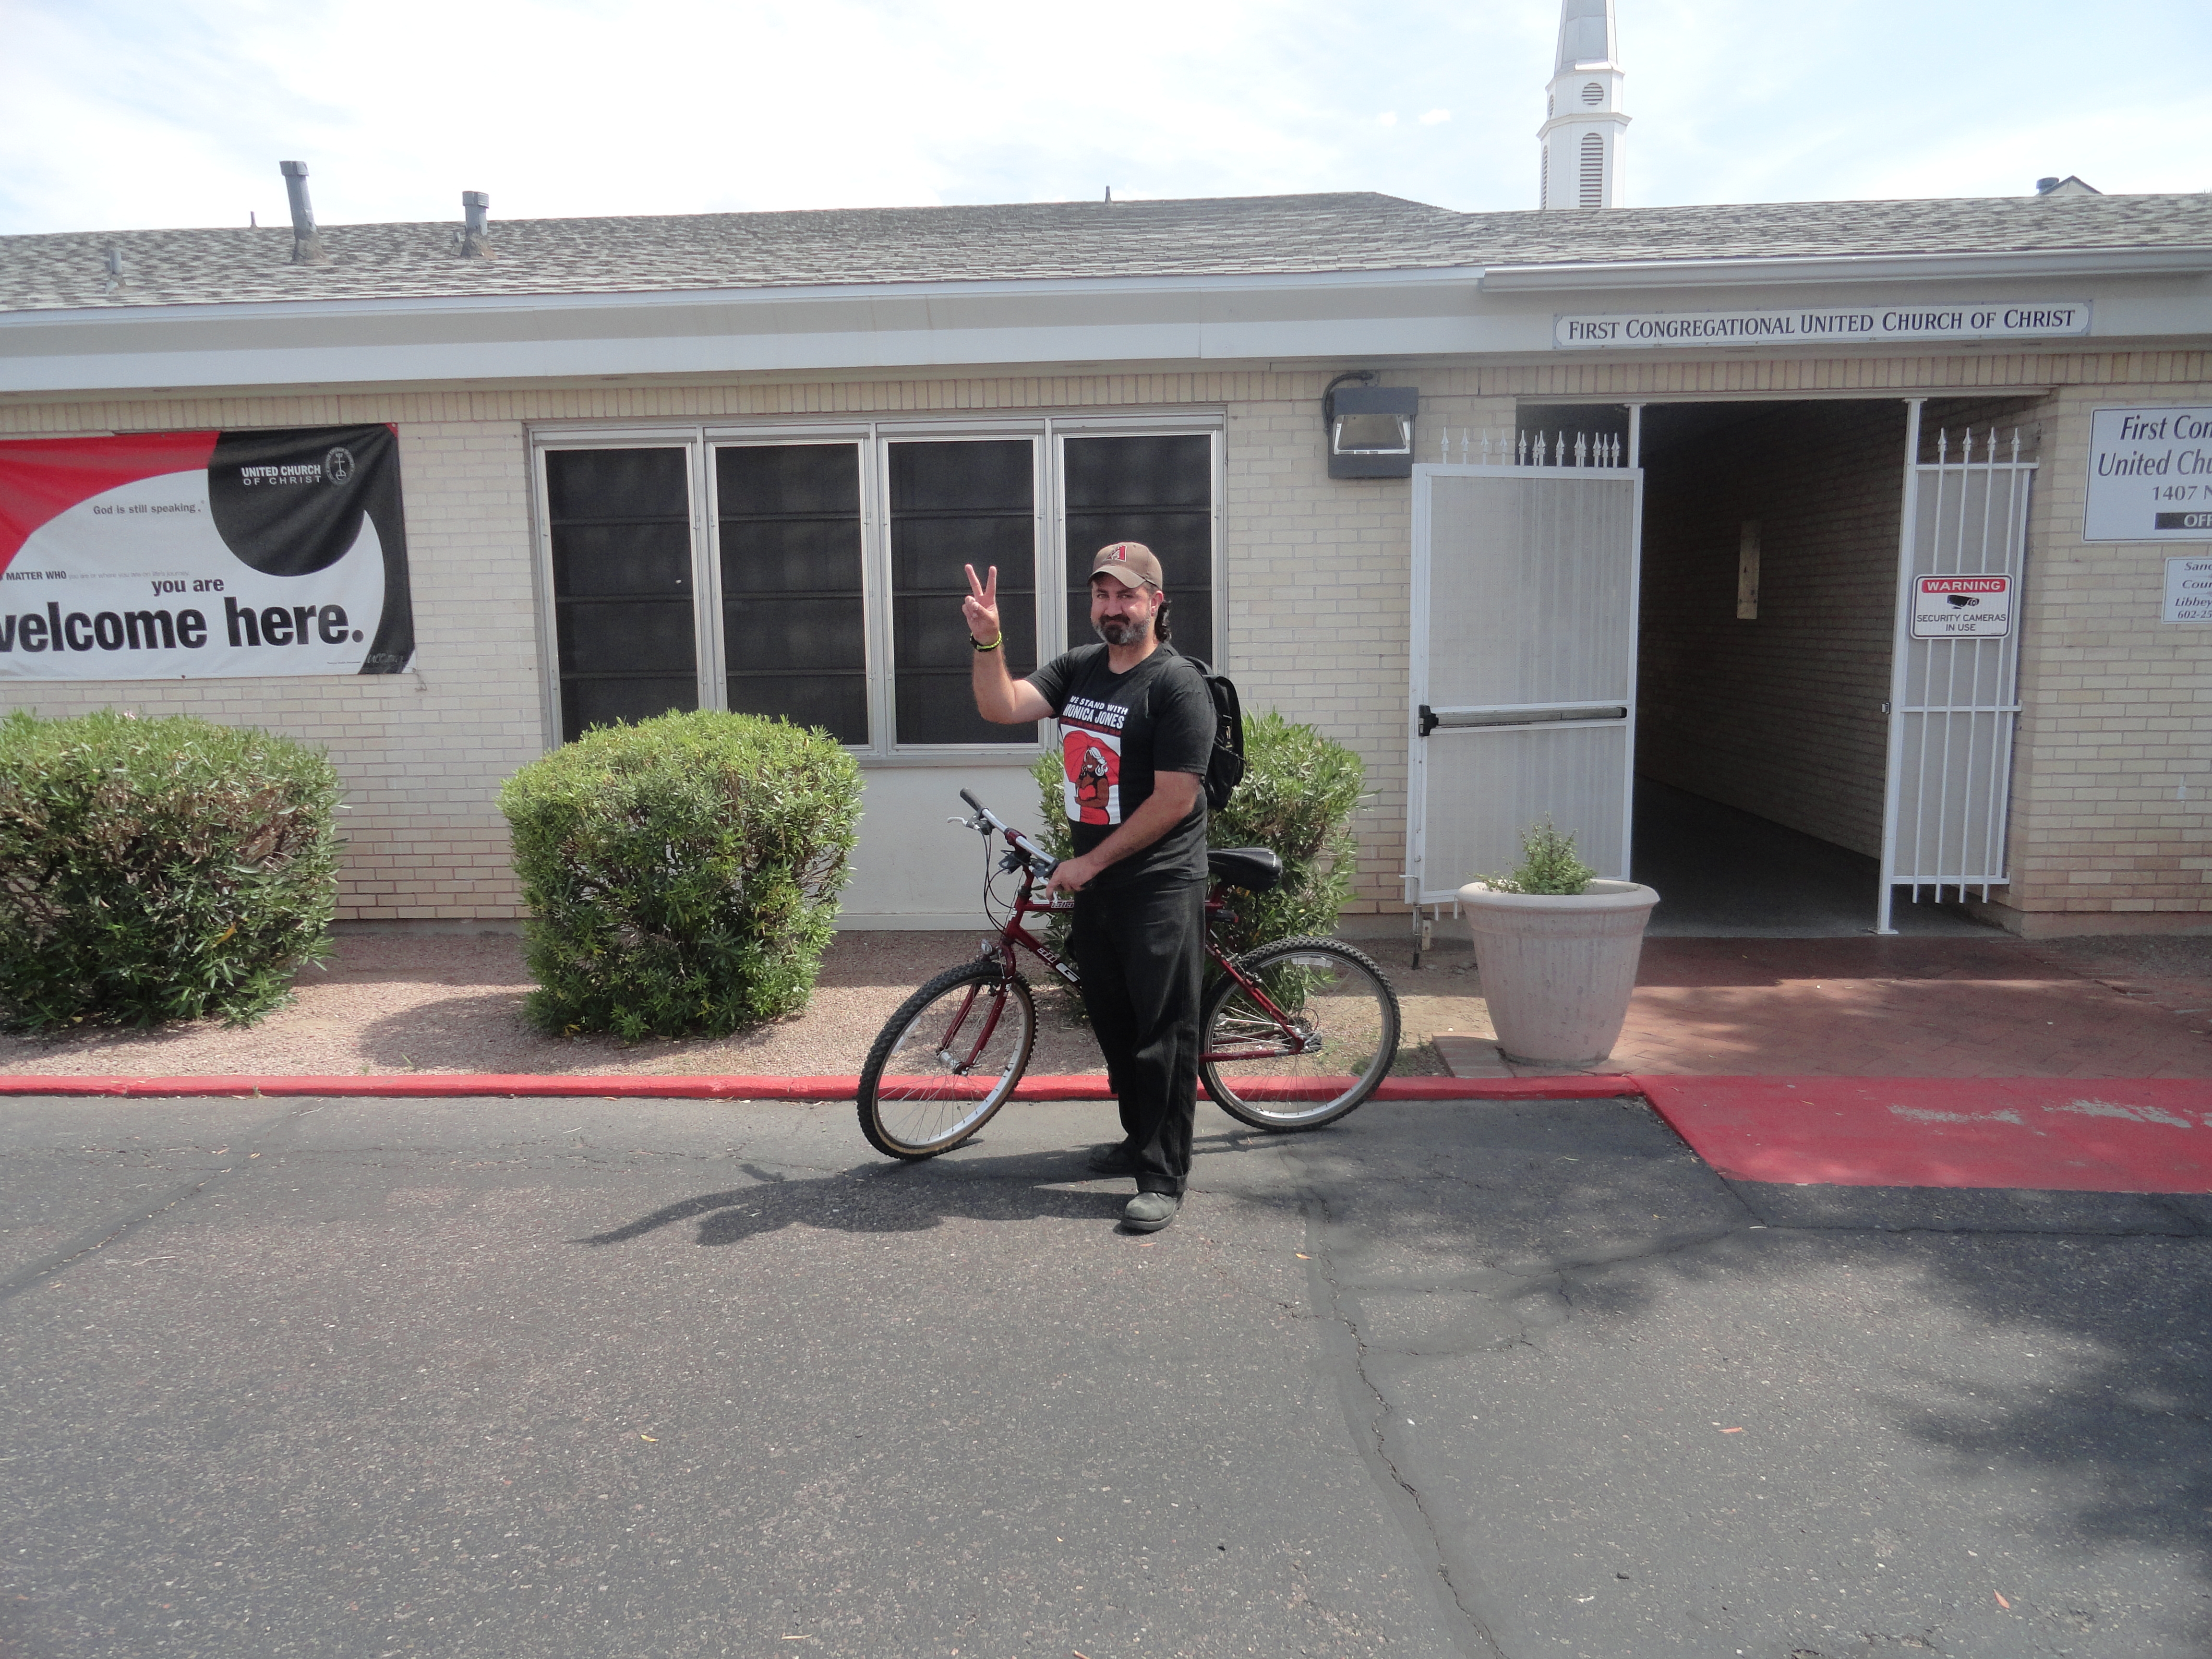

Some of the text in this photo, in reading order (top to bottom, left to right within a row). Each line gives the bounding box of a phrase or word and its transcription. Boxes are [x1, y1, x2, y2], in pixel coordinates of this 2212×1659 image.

[1568, 309, 2076, 339] FIRST CONGREGATIONAL UNITED CHURCH OF CHRIST
[2120, 414, 2168, 441] First
[241, 464, 321, 477] UNITED CHURCH
[2098, 449, 2172, 477] United
[243, 476, 321, 486] OF CHRIST
[2152, 485, 2198, 501] 1407
[93, 505, 113, 515] God
[117, 505, 125, 514] is
[129, 504, 147, 514] still
[6, 571, 43, 581] MATTER
[45, 570, 67, 579] WHO
[151, 578, 224, 597] you are
[1926, 581, 2001, 591] WARNING
[224, 597, 364, 647] here.
[1079, 698, 1105, 709] STAND
[1107, 704, 1129, 715] WITH
[1062, 704, 1094, 722] MONICA
[1094, 711, 1125, 729] JONES
